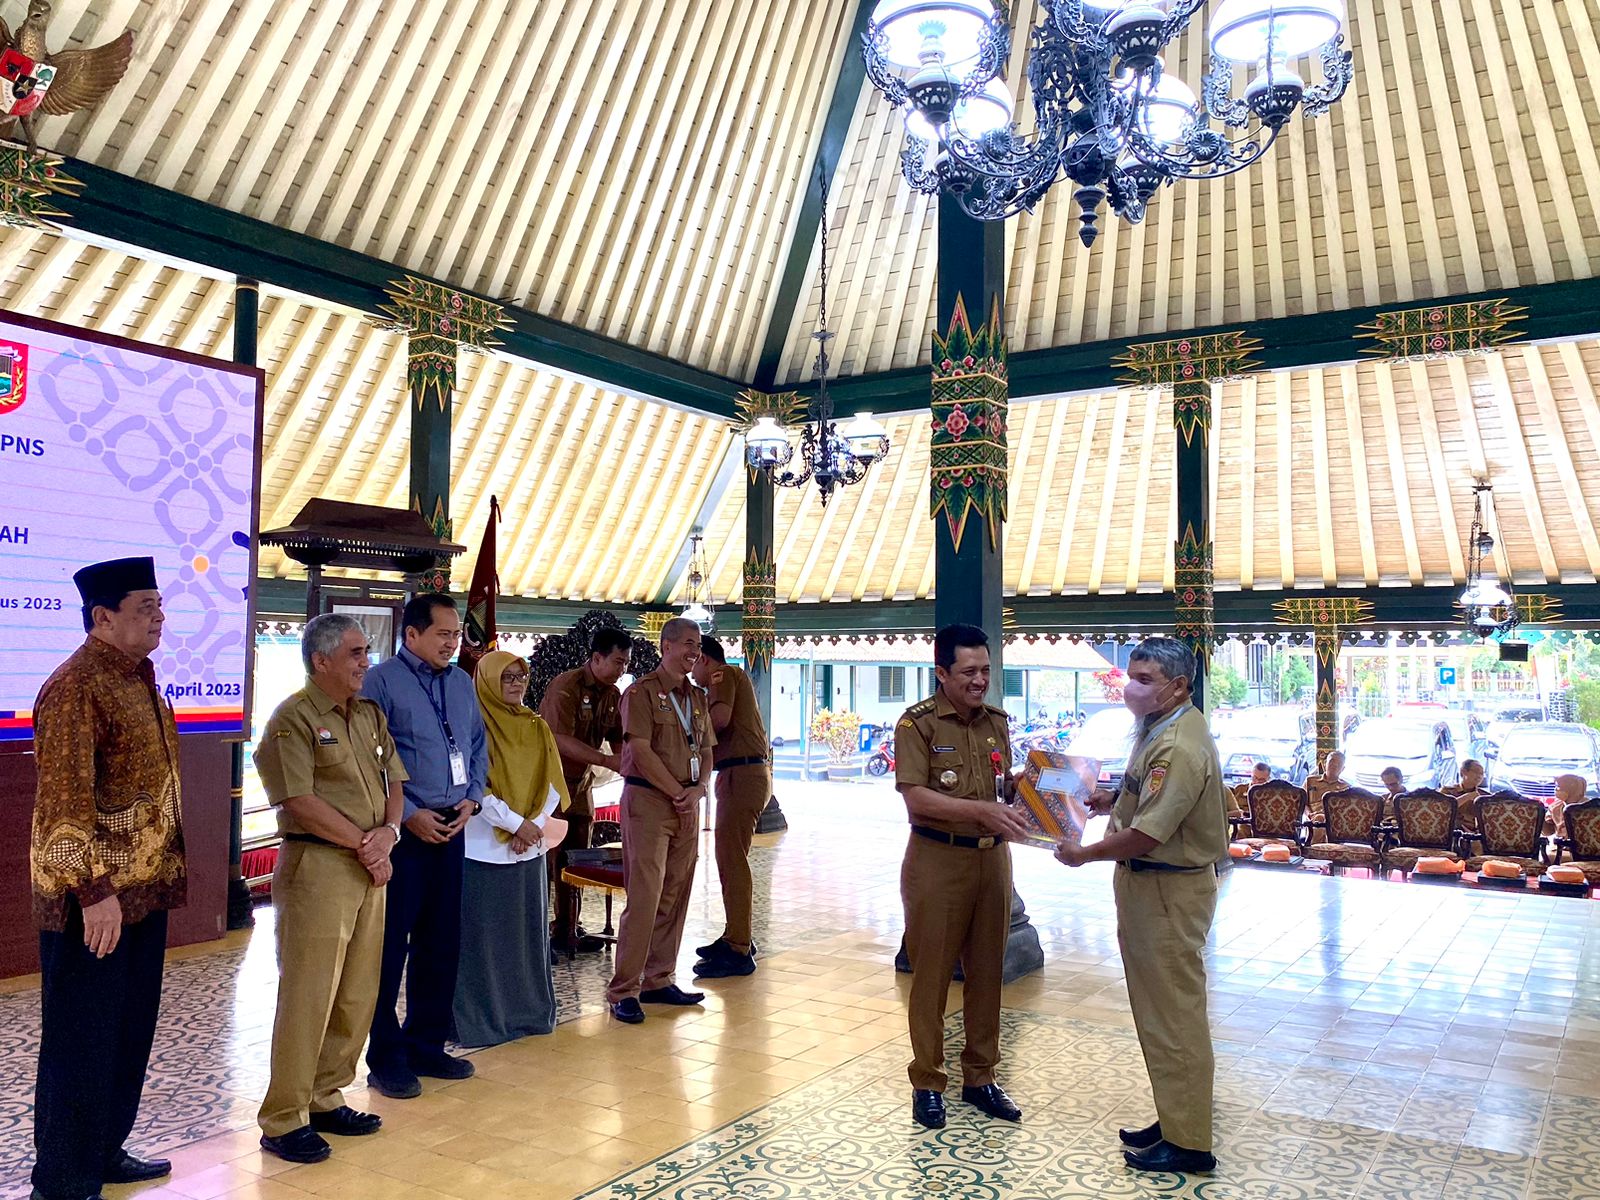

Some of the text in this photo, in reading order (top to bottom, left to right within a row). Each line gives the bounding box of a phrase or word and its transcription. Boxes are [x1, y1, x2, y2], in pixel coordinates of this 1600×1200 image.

[1, 434, 45, 457] PNS
[0, 525, 29, 545] AH
[0, 597, 62, 610] us 2023
[164, 682, 203, 700] April
[205, 683, 241, 697] 2023
[861, 727, 870, 748] P
